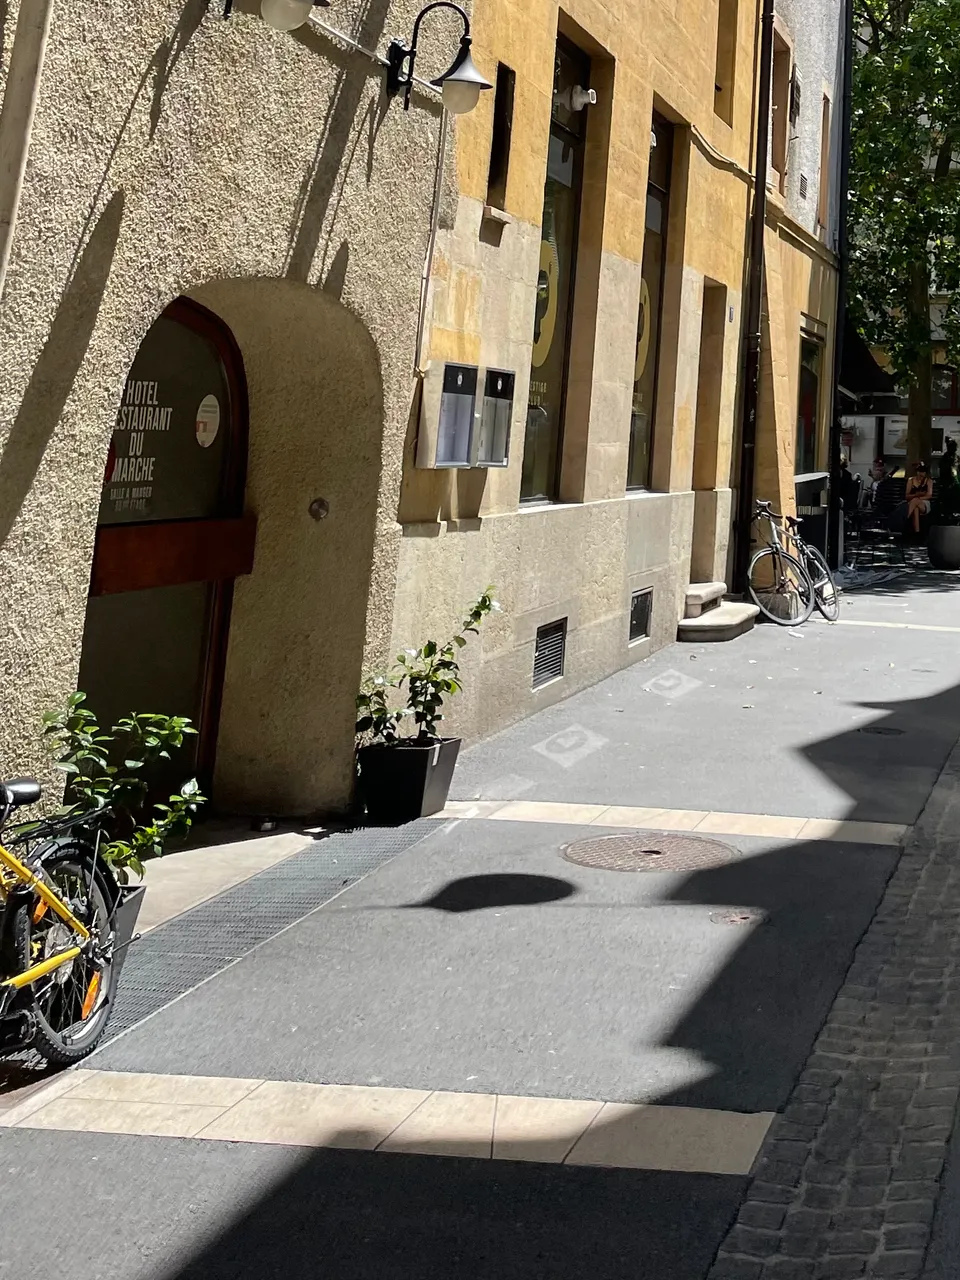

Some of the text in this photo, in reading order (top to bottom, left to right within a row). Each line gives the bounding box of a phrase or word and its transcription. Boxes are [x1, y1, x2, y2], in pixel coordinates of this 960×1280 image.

[125, 380, 159, 405] HOTEL
[114, 406, 173, 431] ESTAURANT
[128, 432, 144, 457] DU
[111, 457, 156, 482] MARCHE
